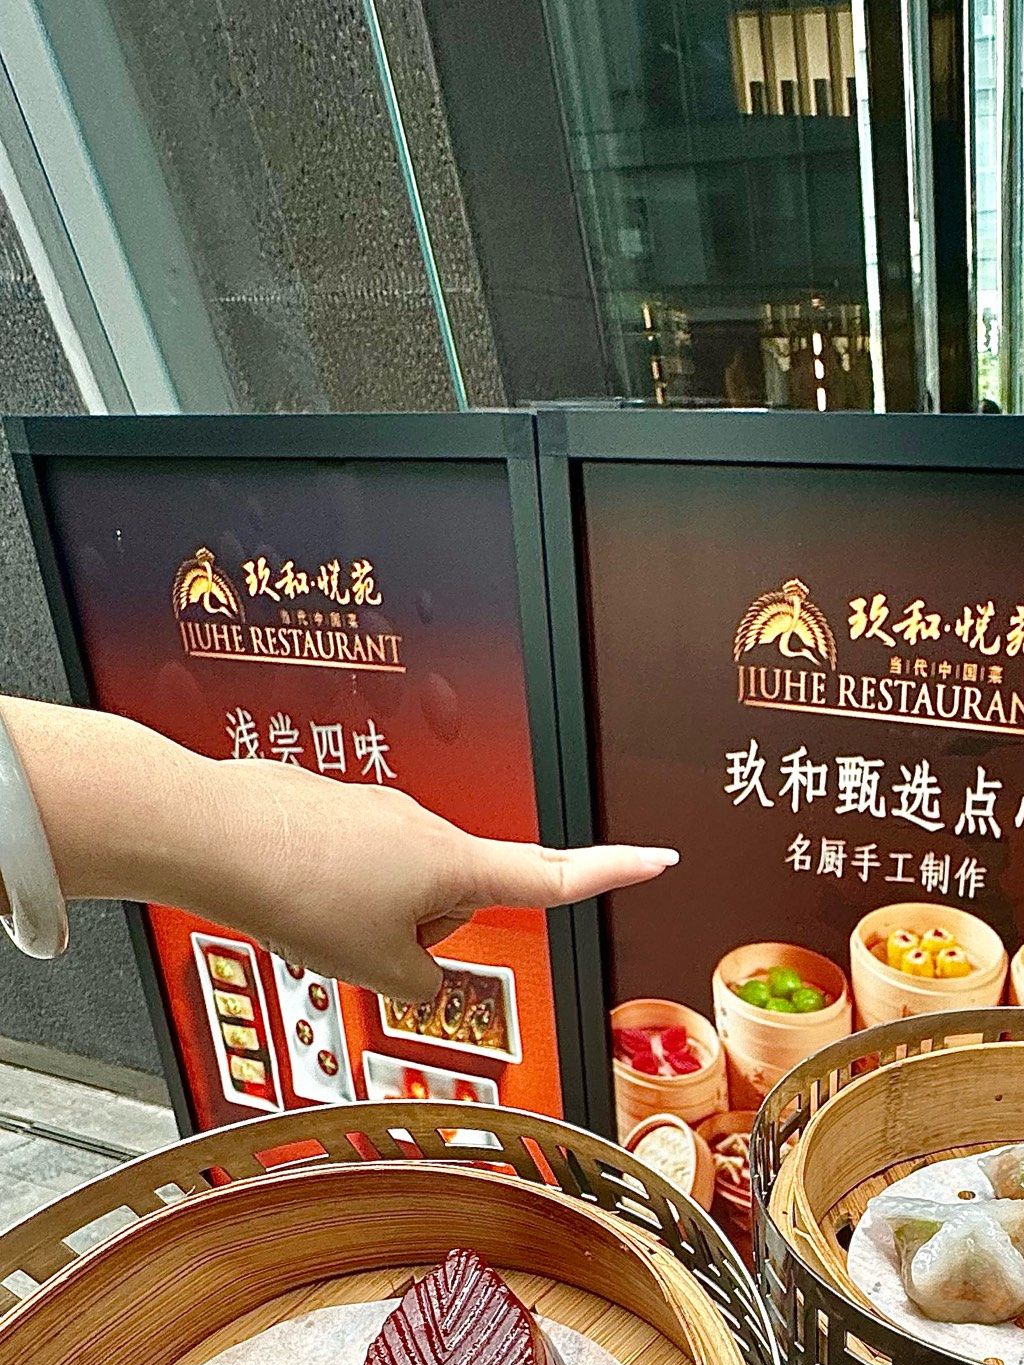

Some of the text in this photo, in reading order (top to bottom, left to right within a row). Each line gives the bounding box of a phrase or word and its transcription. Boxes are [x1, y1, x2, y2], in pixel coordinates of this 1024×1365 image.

[179, 621, 403, 664] JIUHE RESTAURANT
[737, 665, 827, 704] JIUHE
[225, 706, 398, 785] 浅尝四味
[784, 832, 988, 899] 名厨手工制作
